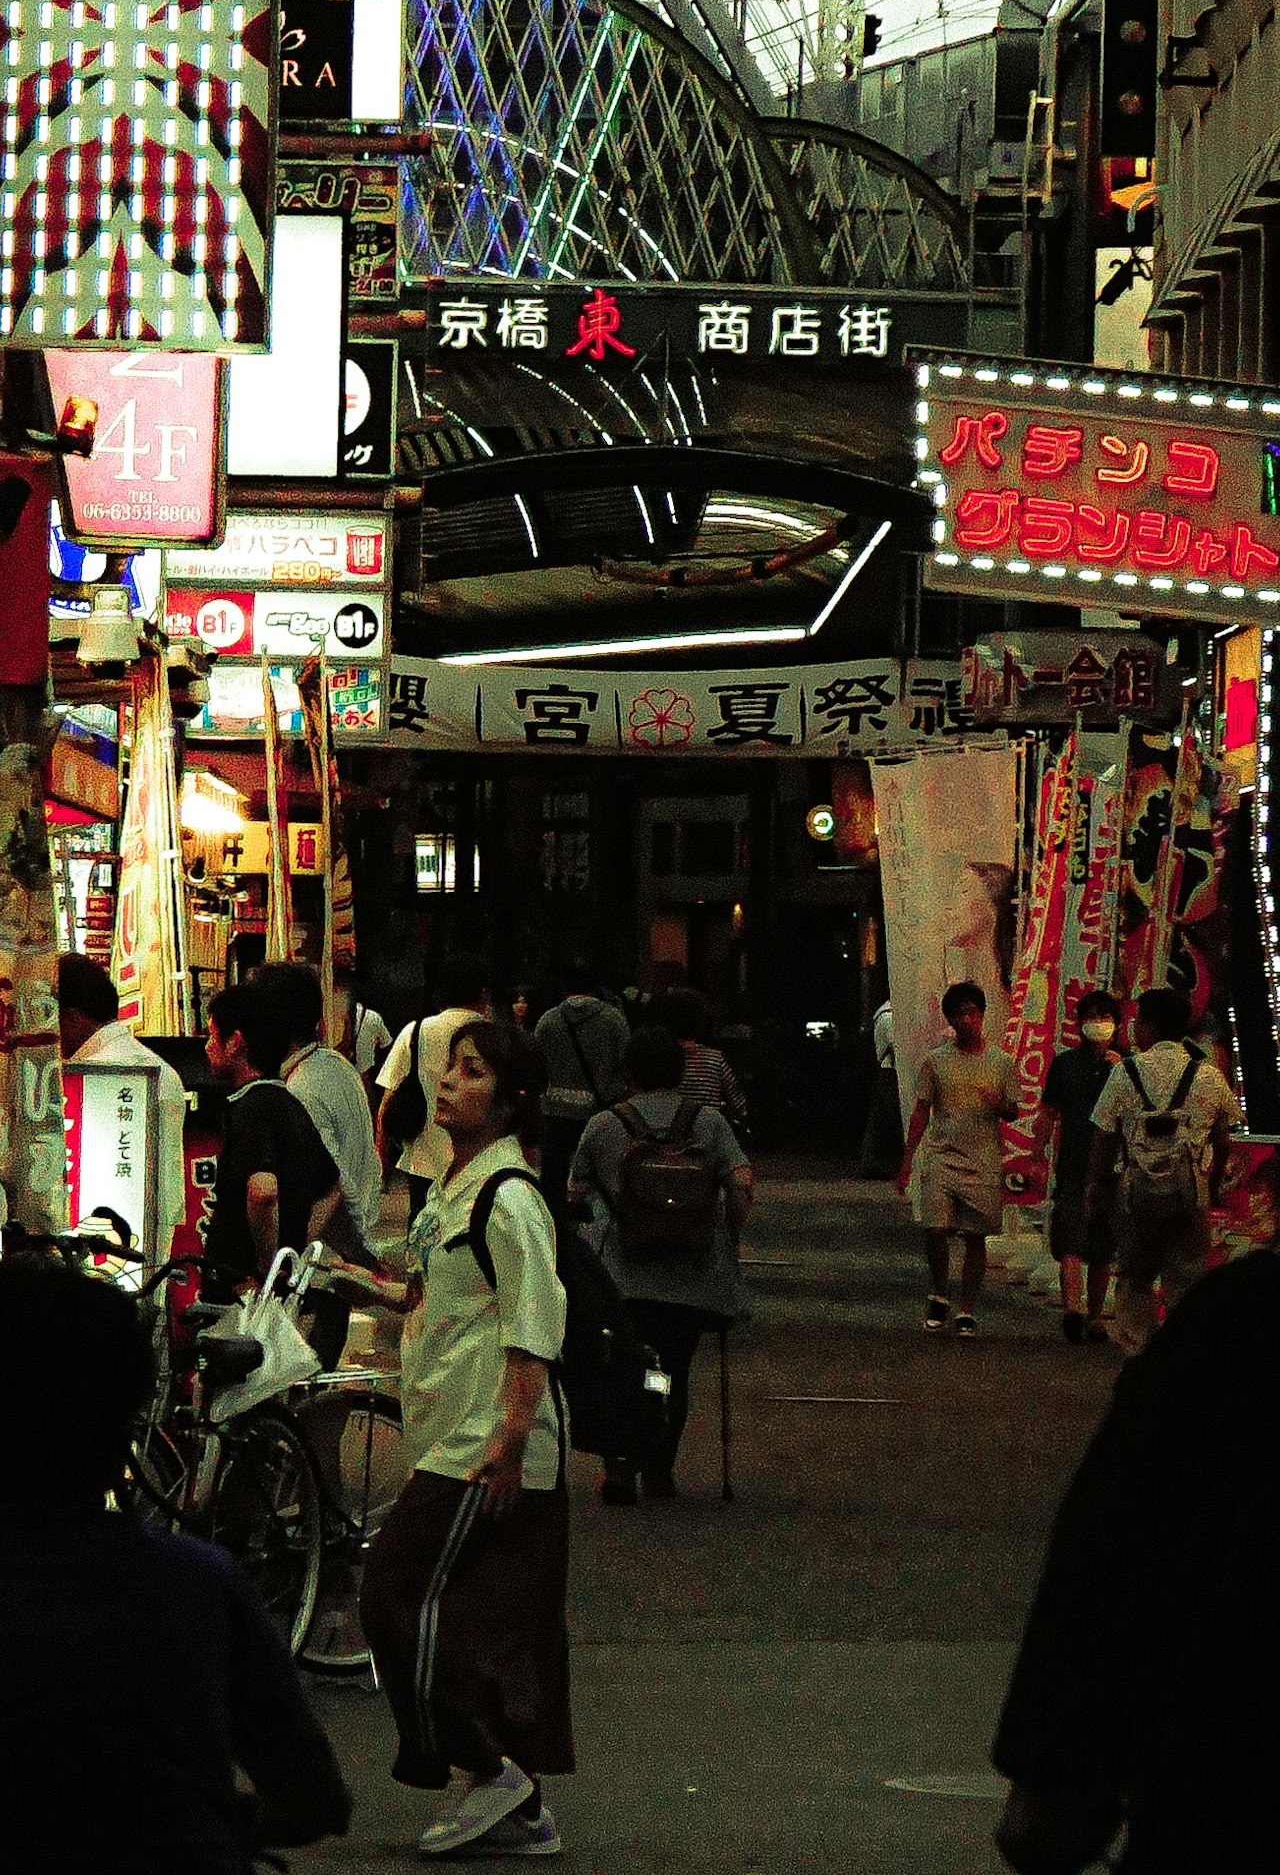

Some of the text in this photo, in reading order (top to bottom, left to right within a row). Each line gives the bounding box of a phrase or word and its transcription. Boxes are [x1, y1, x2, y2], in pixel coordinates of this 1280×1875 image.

[696, 301, 893, 359] 商店街
[94, 397, 198, 483] 4F
[940, 410, 1222, 498] パチンコ
